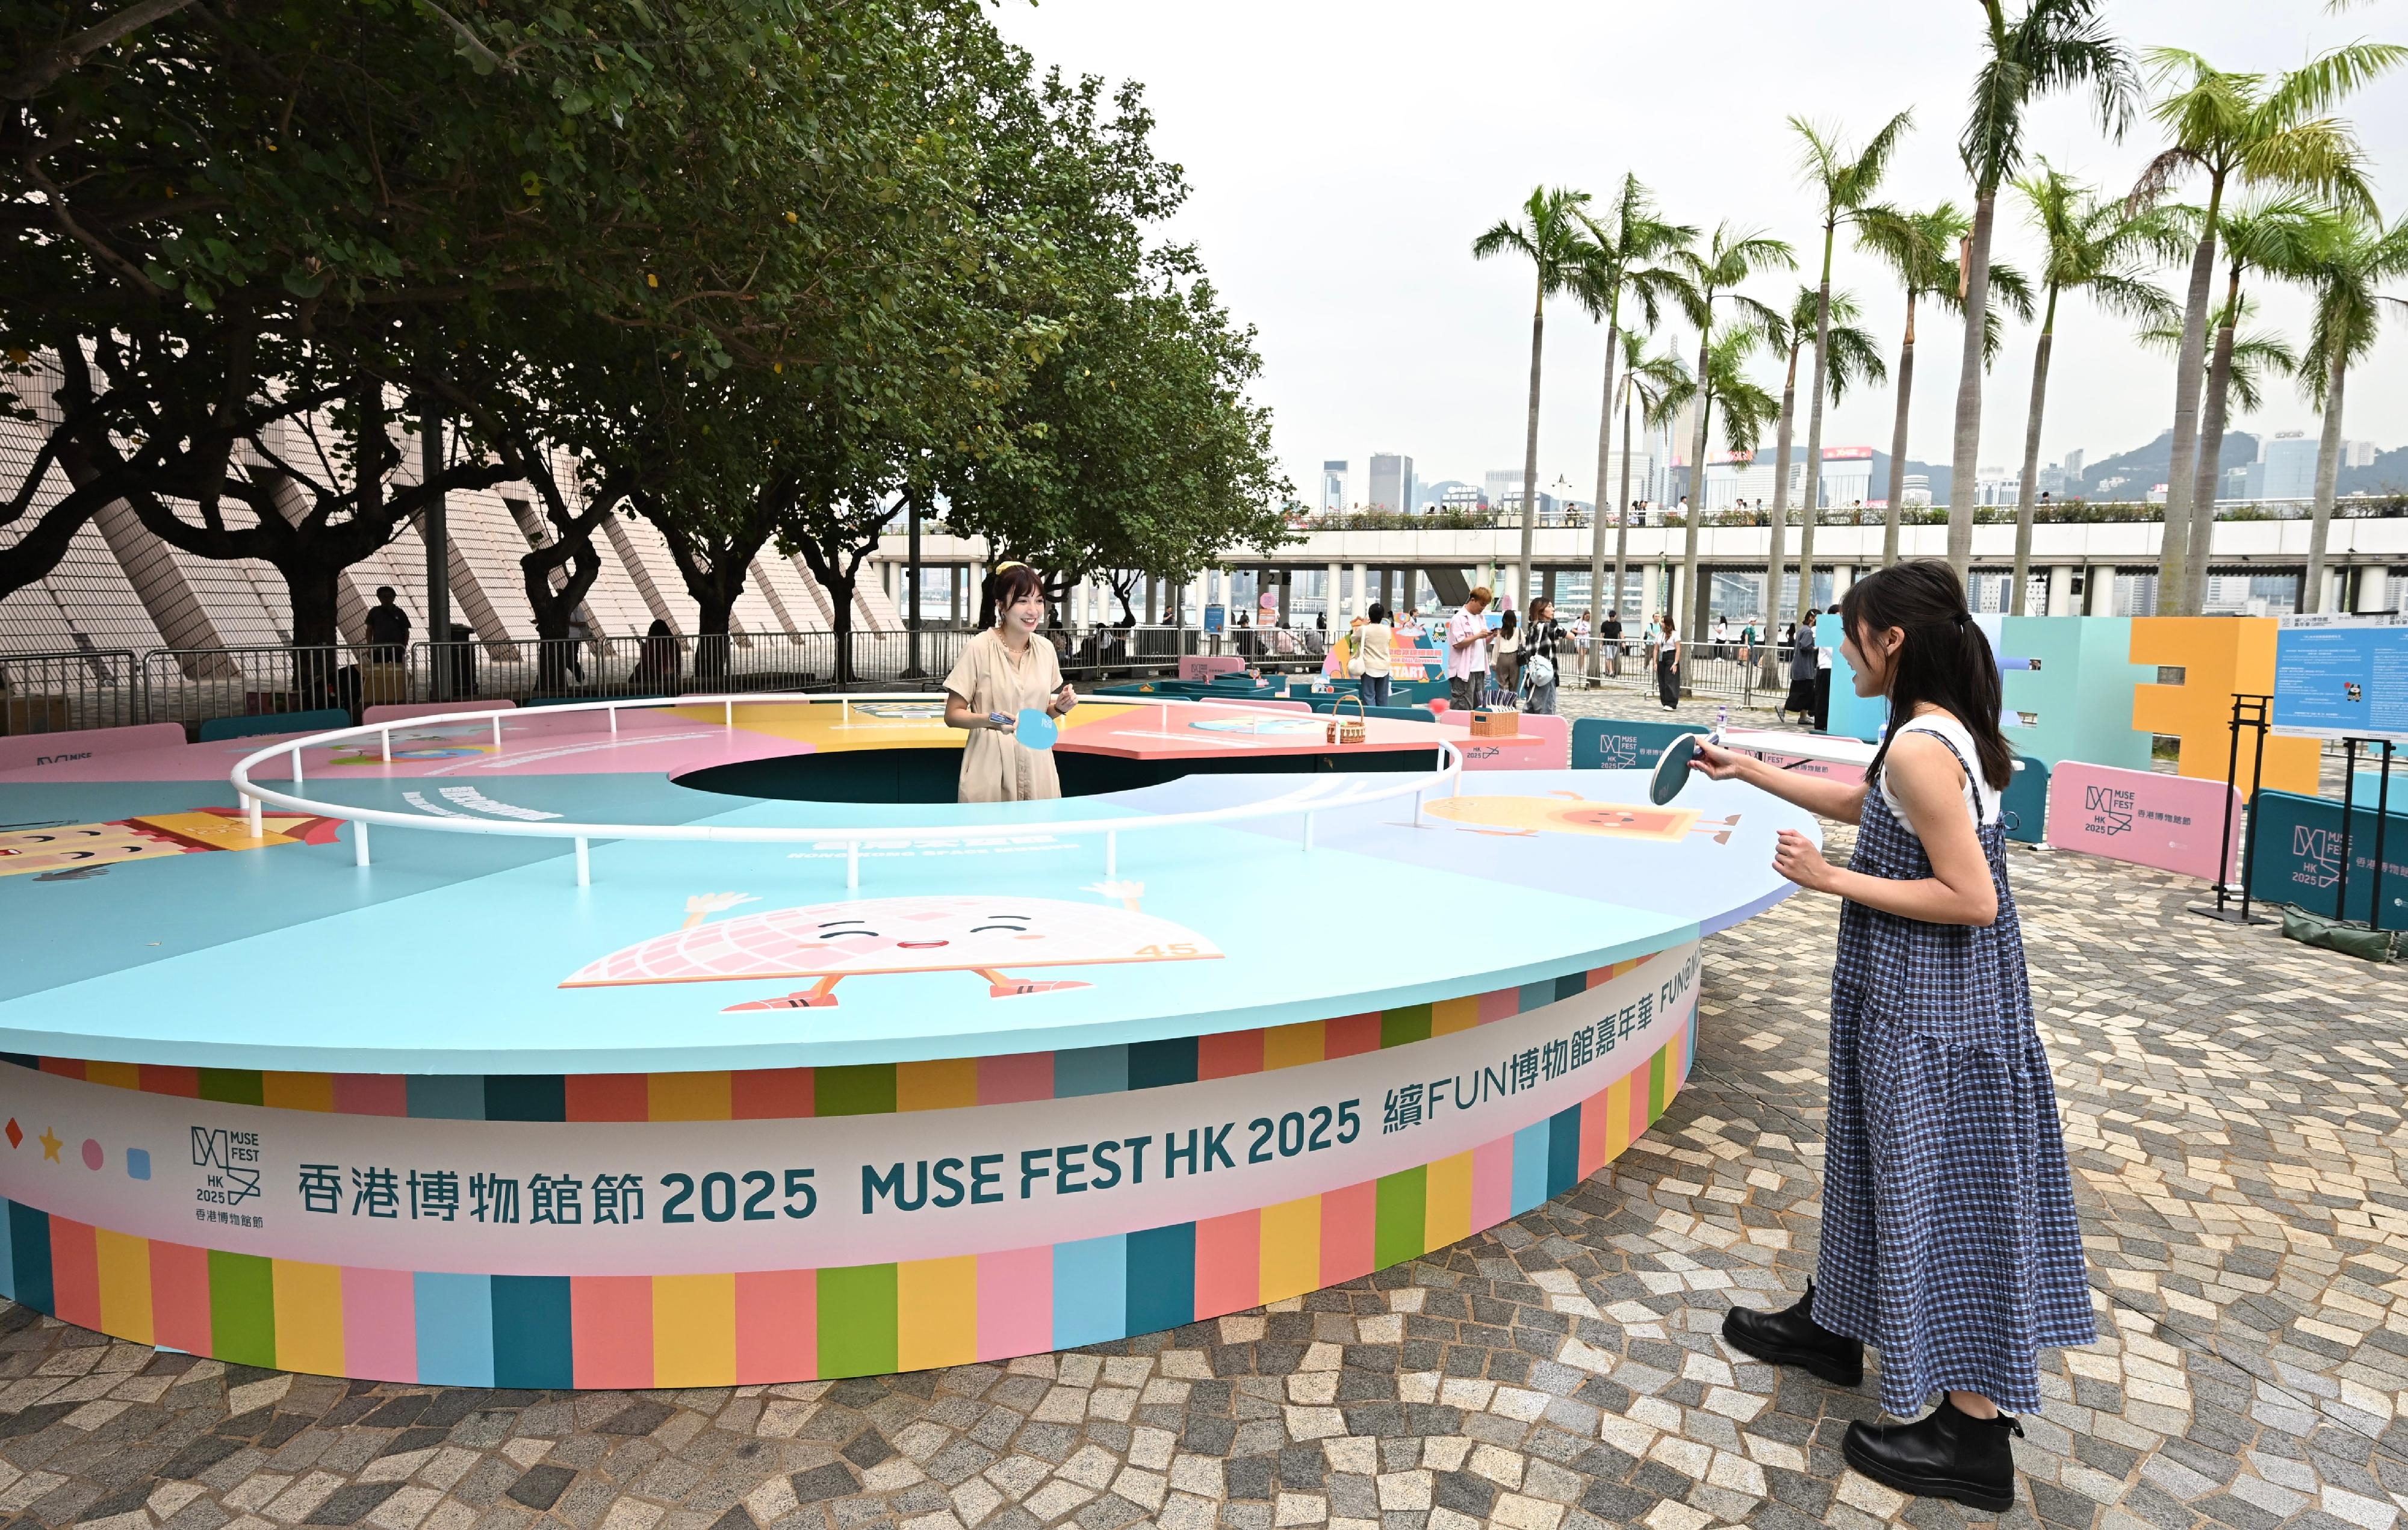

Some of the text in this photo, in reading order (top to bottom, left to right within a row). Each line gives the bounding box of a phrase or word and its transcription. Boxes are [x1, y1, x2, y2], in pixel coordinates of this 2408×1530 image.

[1268, 573, 1275, 584] 2
[2114, 790, 2135, 801] MUSE
[2114, 800, 2134, 810] FEST
[2094, 815, 2106, 824] HK
[2138, 810, 2191, 826] 香港博物館節
[2085, 823, 2105, 834] 2025
[2303, 862, 2318, 873] HK
[2292, 872, 2316, 885] 2025
[1134, 943, 1199, 959] 45
[231, 1131, 259, 1146] MUSE
[231, 1147, 259, 1162] FEST
[861, 1098, 1361, 1215] MUSE FEST HK 2025
[207, 1174, 224, 1188] HK
[196, 1188, 225, 1204] 2025
[299, 1164, 817, 1225] 香港博物館節 2025
[196, 1208, 263, 1228] 香港博物館節
